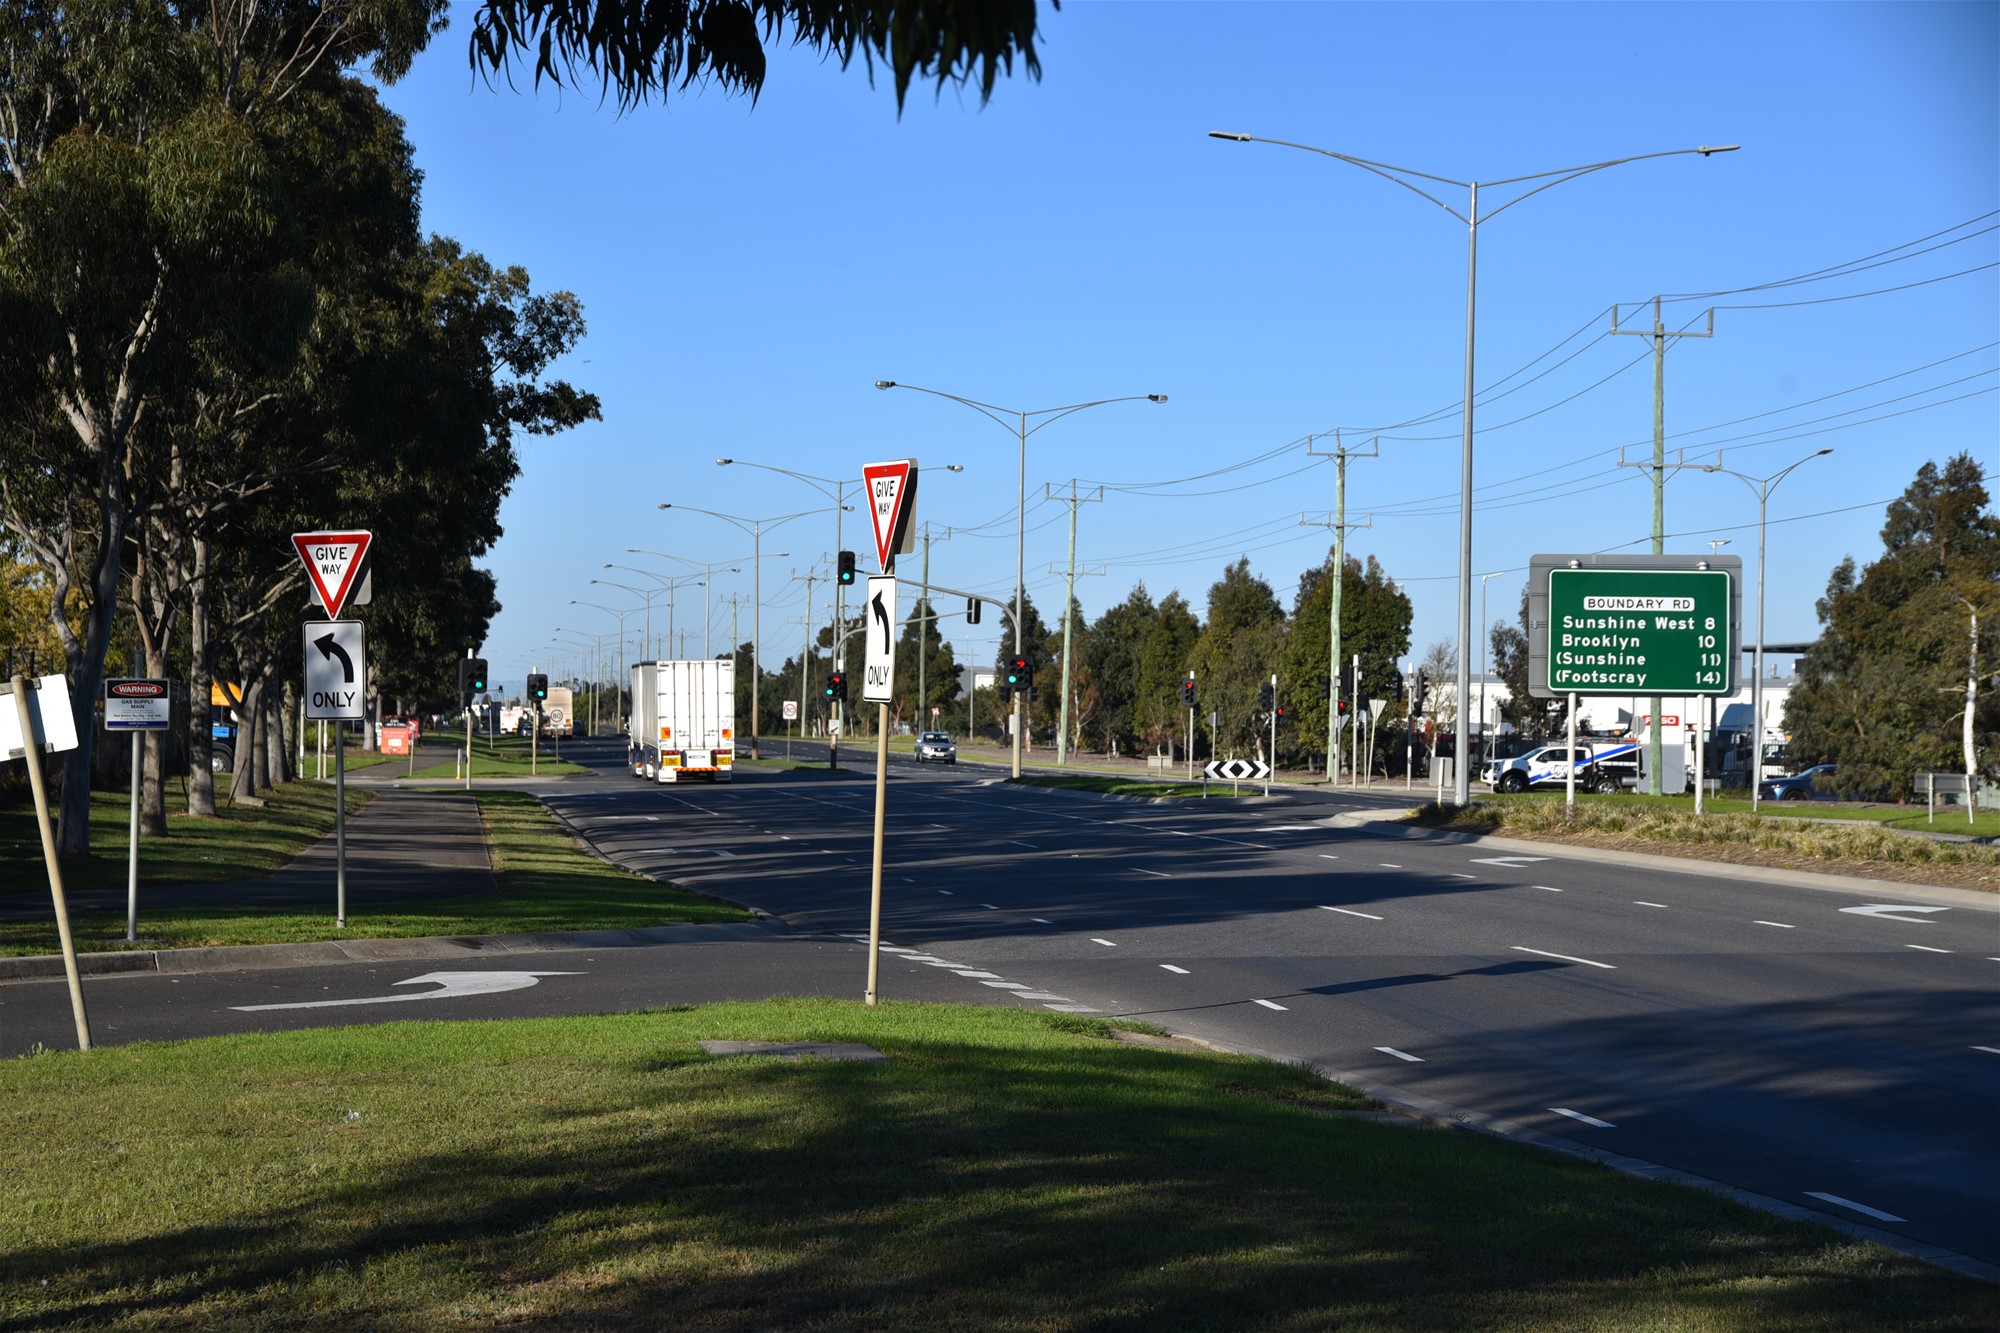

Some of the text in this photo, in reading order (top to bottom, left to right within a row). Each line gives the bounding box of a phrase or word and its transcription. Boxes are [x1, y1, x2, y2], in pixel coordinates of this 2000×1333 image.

[876, 480, 895, 498] GIVE
[878, 502, 890, 516] WAY
[316, 547, 348, 560] GIVE
[321, 564, 341, 575] WAY
[1588, 598, 1691, 609] BOUNDARY RD
[1563, 616, 1716, 630] Sunshine West 8
[1562, 634, 1716, 650] Brooklyn 10
[1556, 651, 1721, 666] (Sunshine 11)
[868, 665, 889, 687] ONLY
[1556, 669, 1721, 686] (Footscray 14)
[313, 691, 355, 708] ONLY
